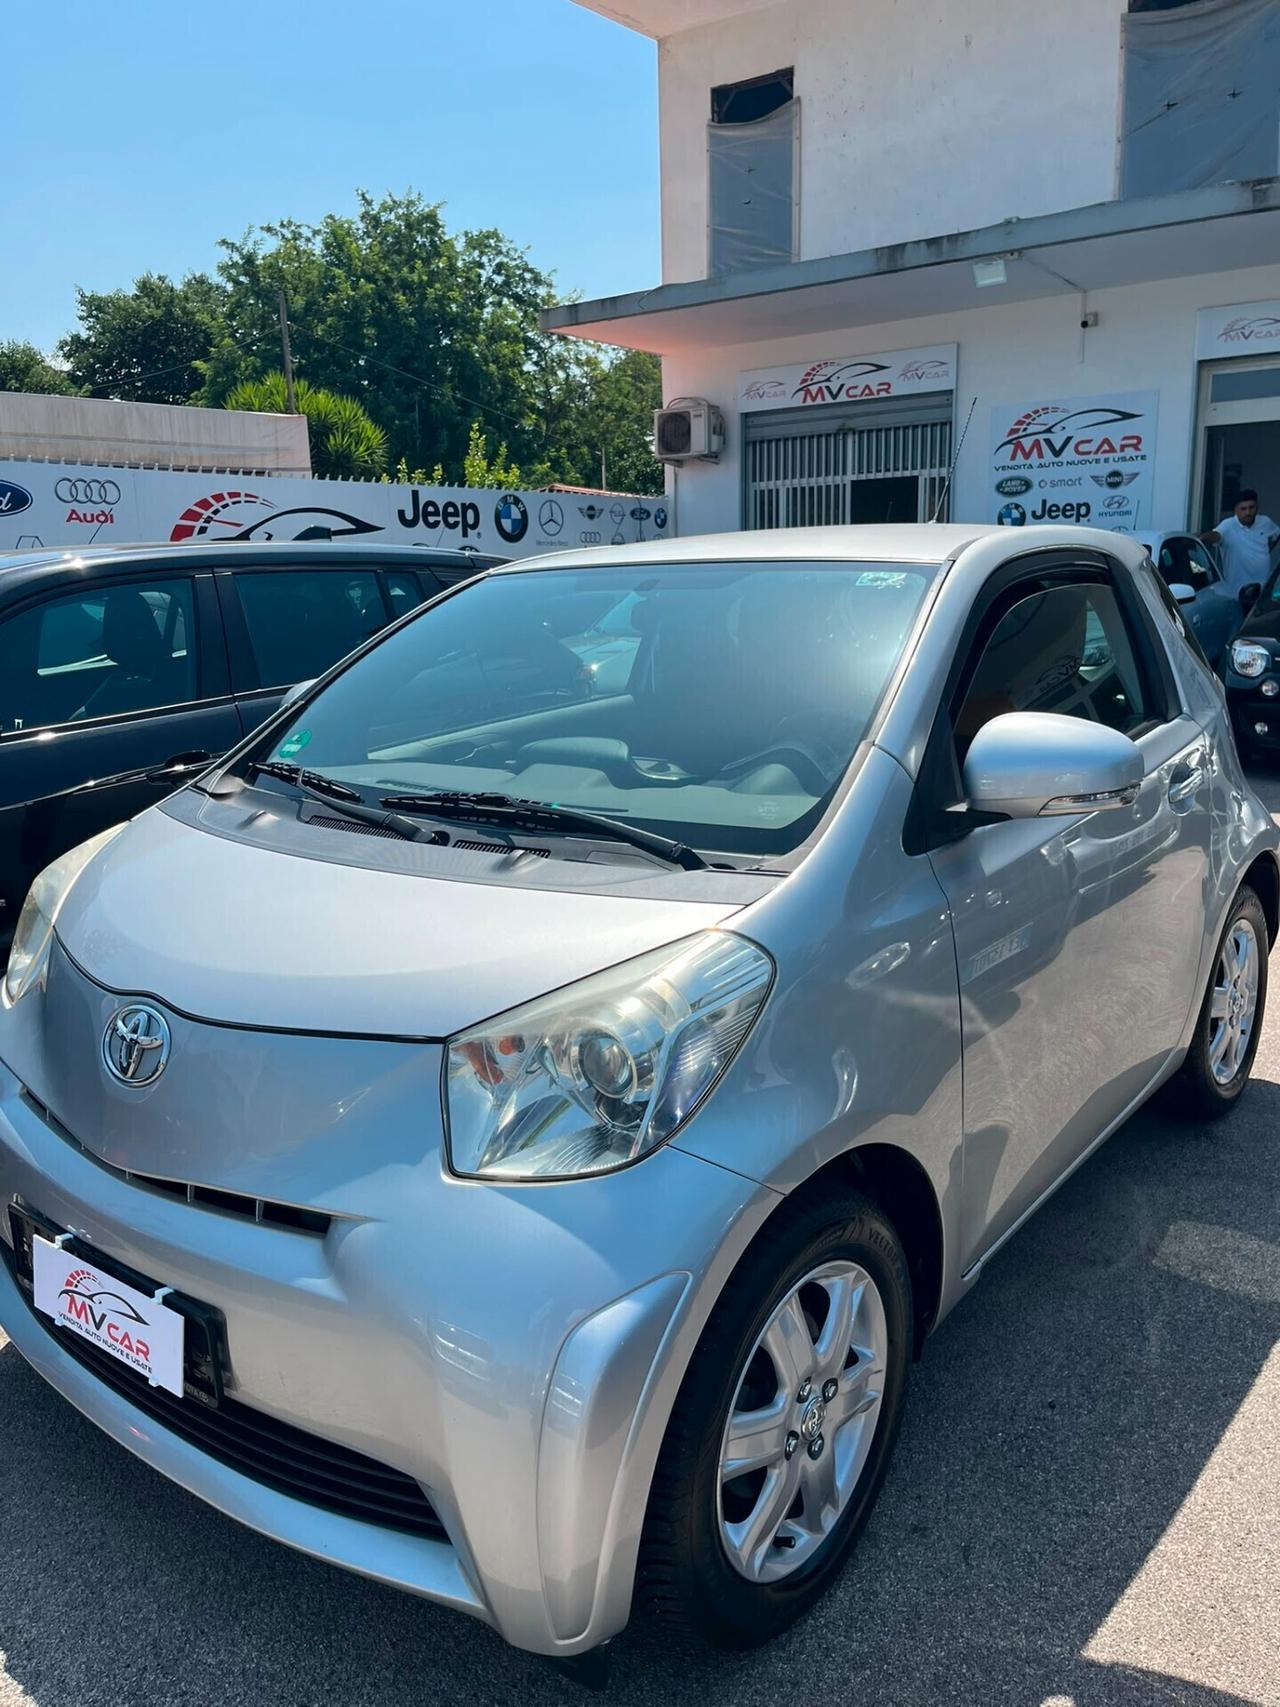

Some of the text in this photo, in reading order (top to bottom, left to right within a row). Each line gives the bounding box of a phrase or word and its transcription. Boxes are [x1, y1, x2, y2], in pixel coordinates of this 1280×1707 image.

[802, 382, 892, 403] MVCAR
[1010, 435, 1142, 461] MVCAR
[994, 454, 1147, 472] VENDITA AUTO NUOVE E USATE
[1050, 477, 1082, 488] smart
[65, 508, 115, 524] Audi
[398, 490, 479, 538] Jeep
[1031, 499, 1091, 523] Jeep
[67, 1294, 151, 1363] MVCAR
[58, 1311, 84, 1331] VENDITA
[84, 1328, 102, 1342] AUTO
[102, 1338, 125, 1357] NUOVE
[130, 1355, 153, 1374] USATE
